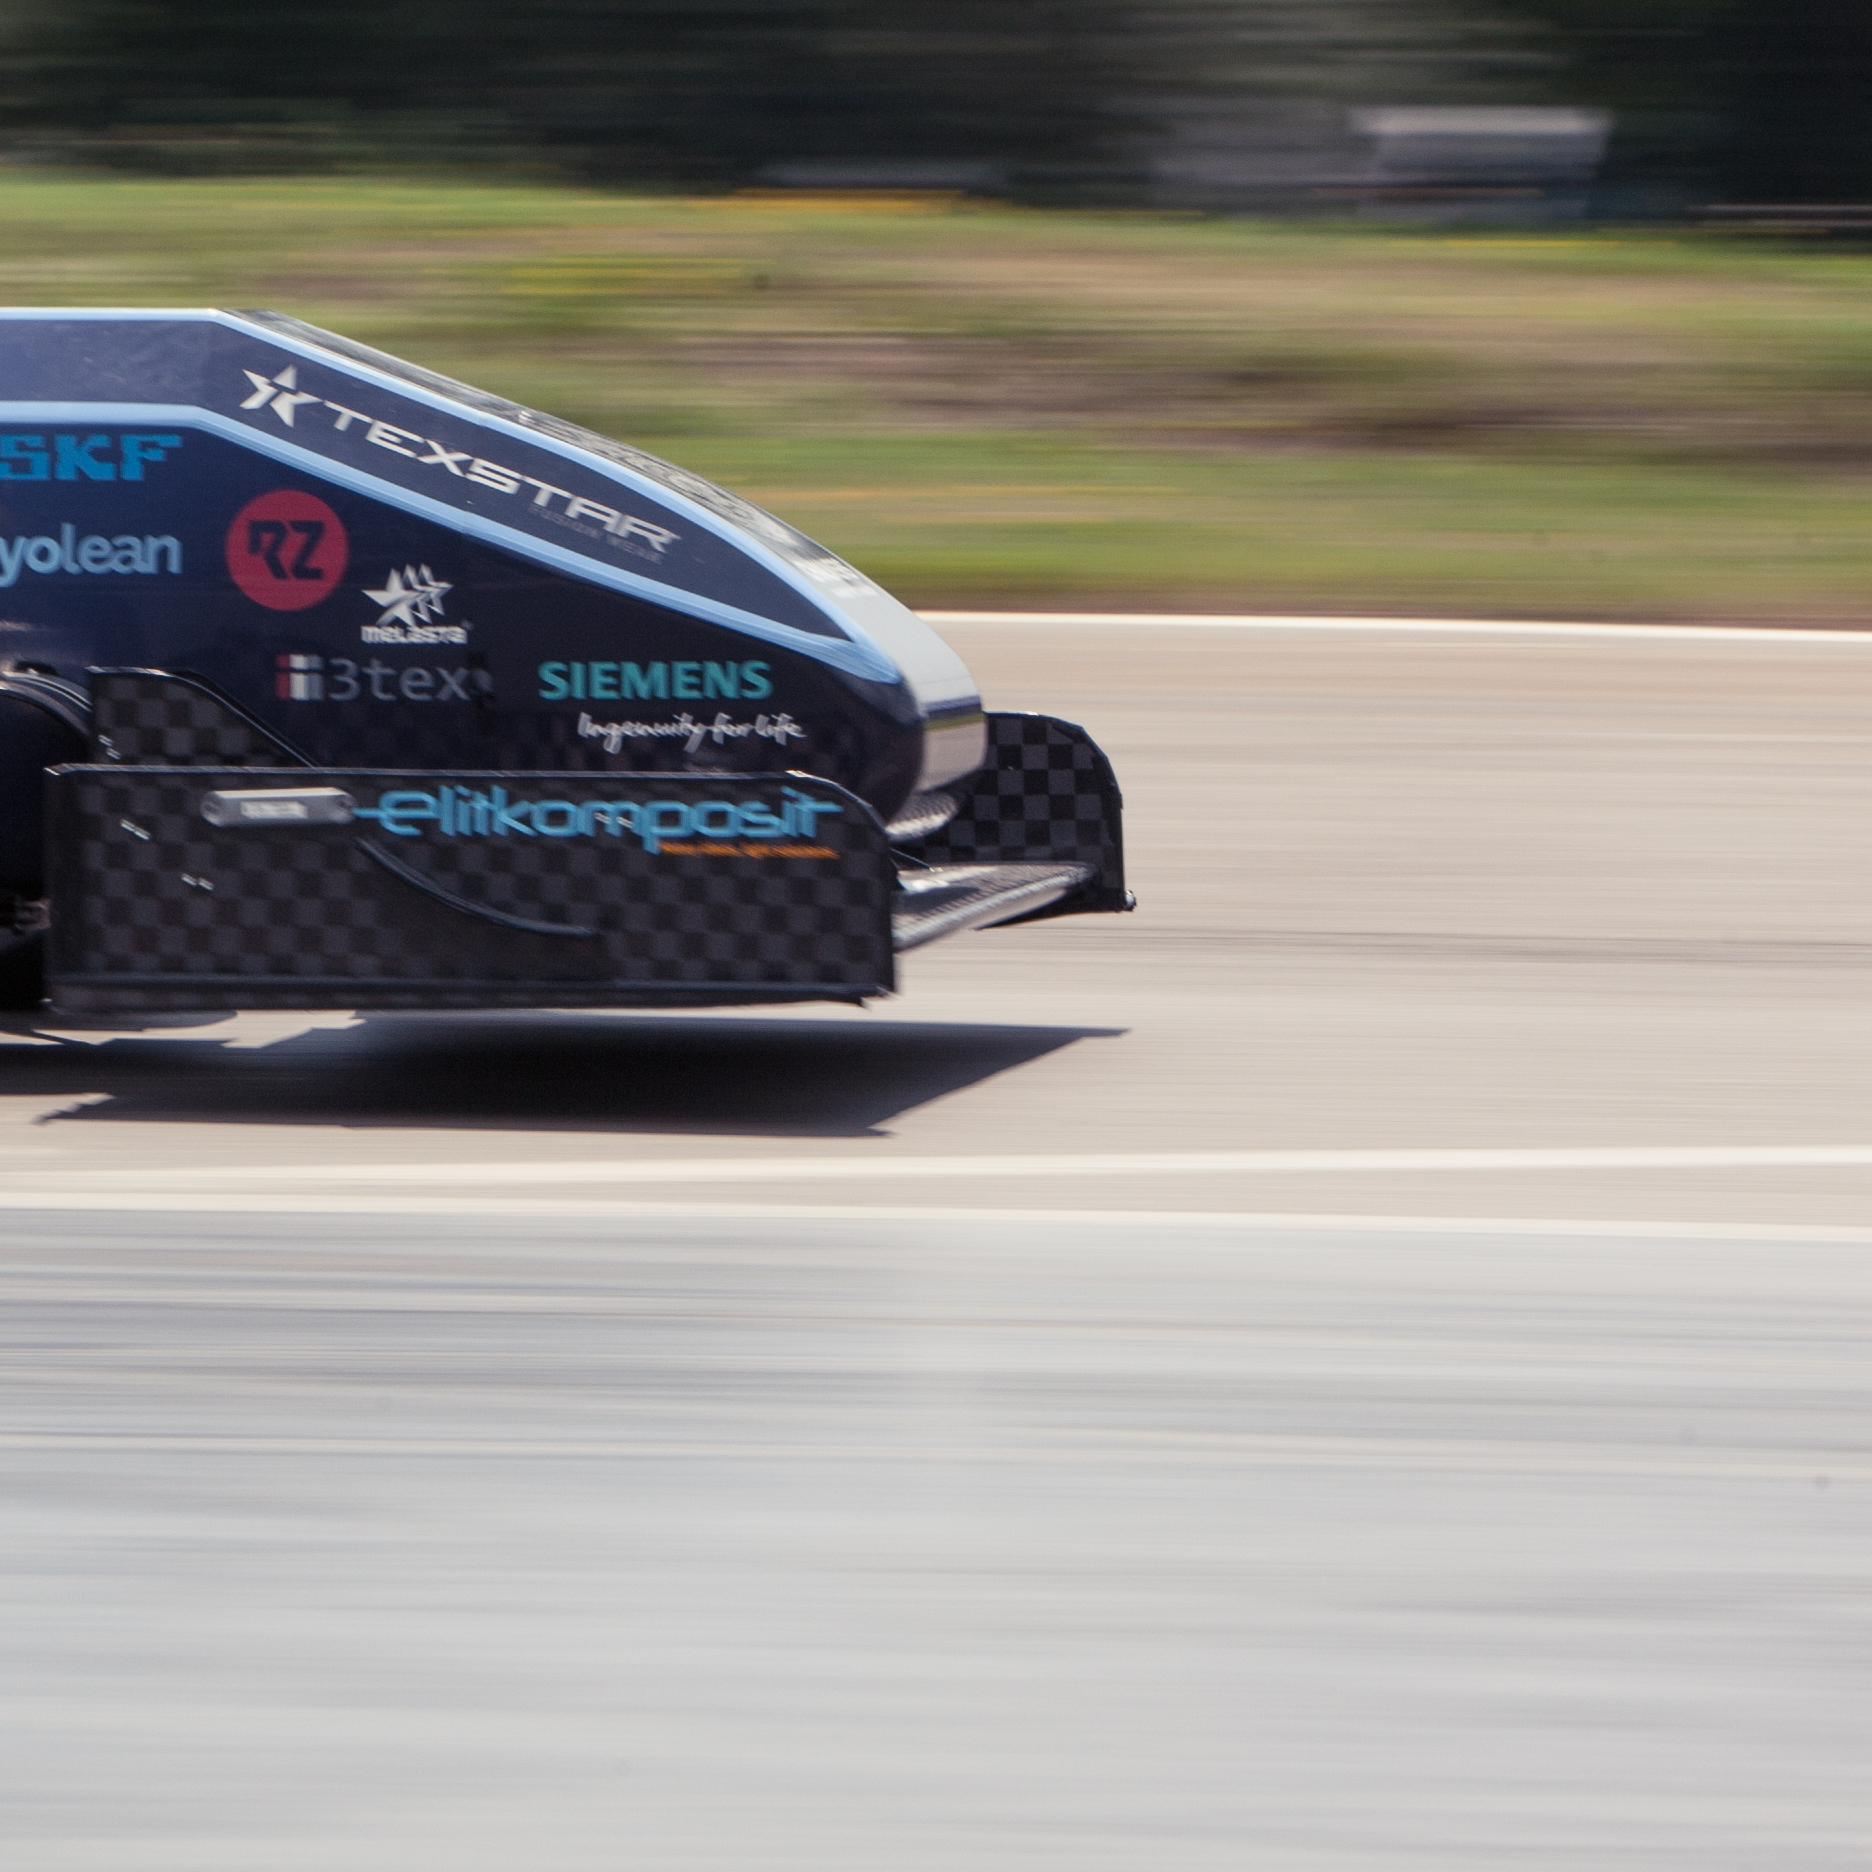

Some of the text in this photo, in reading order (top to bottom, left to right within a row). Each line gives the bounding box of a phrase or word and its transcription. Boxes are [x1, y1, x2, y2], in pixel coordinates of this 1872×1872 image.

[324, 399, 682, 554] TEXSTAR
[248, 520, 326, 581] RZ
[537, 660, 774, 701] SIEMENS
[577, 711, 808, 755] Ingenuity for life
[354, 784, 844, 855] elitkomposit
